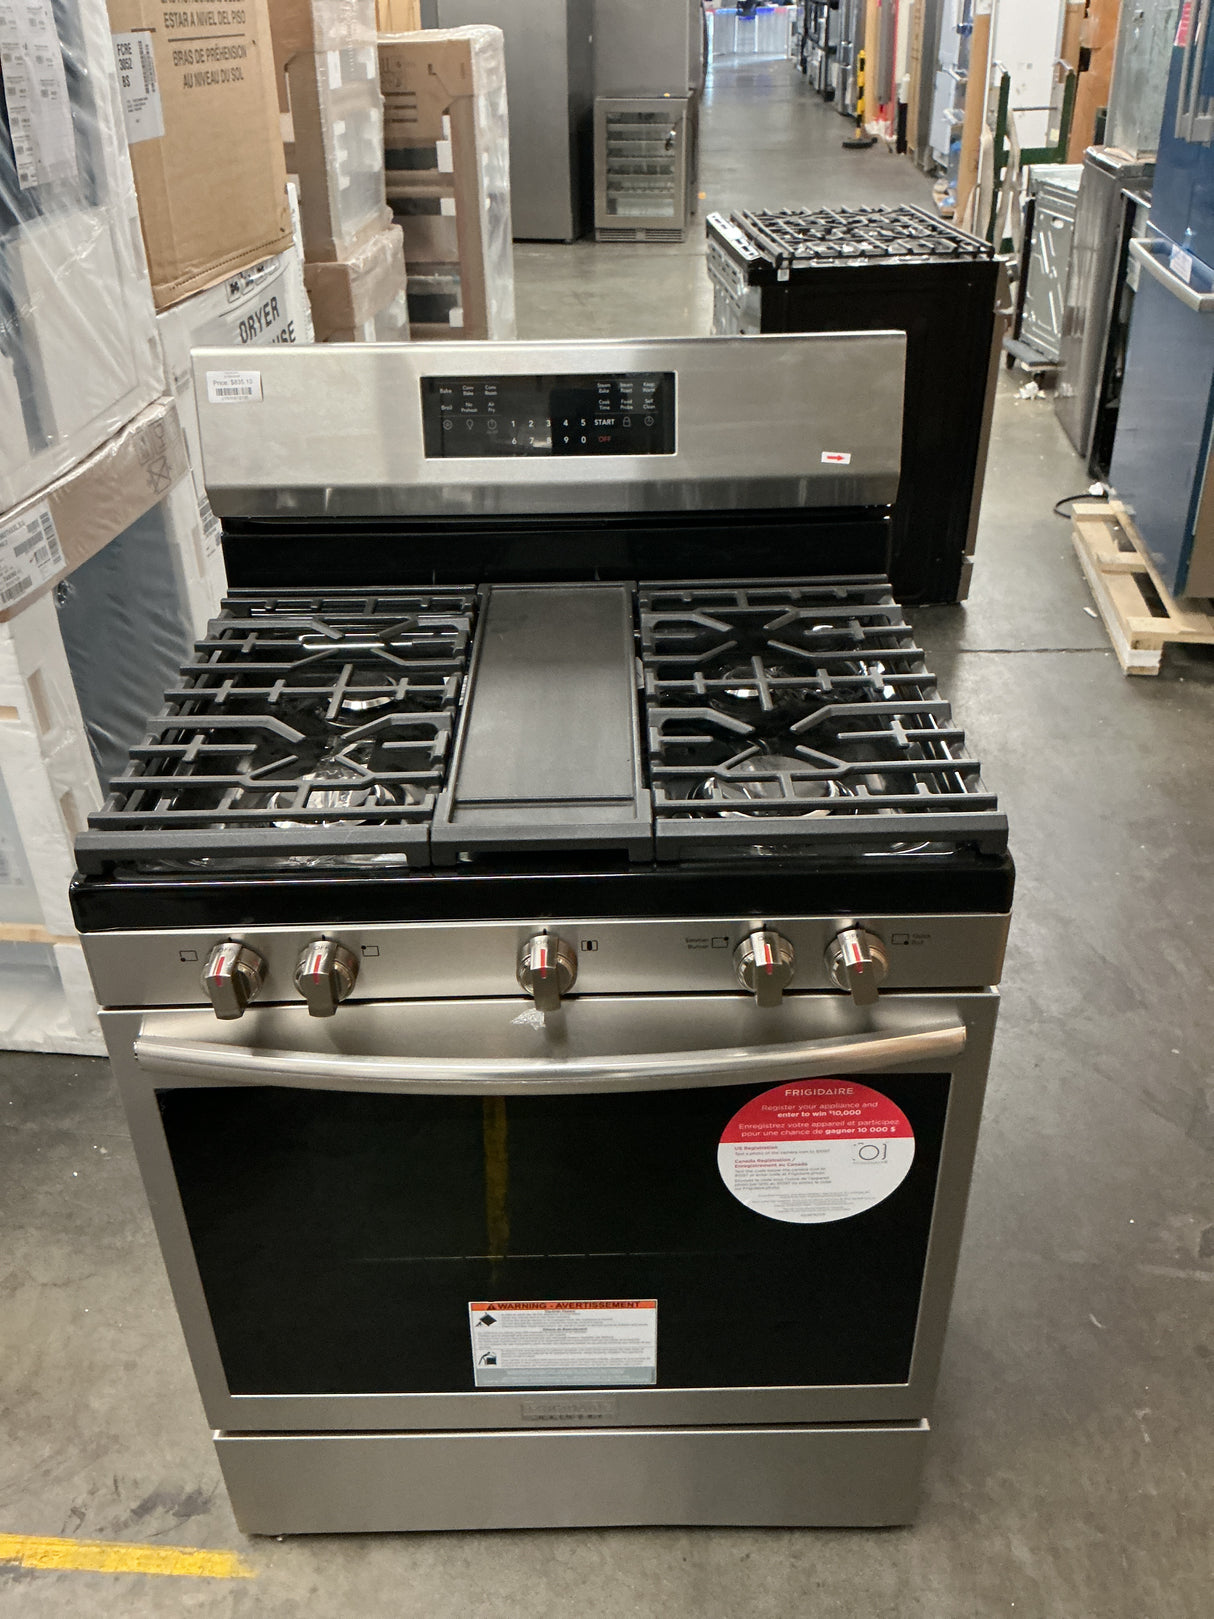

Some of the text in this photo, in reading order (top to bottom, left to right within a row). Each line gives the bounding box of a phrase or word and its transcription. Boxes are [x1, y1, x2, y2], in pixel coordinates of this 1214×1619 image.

[164, 10, 246, 28] ESTAR A NIVEL DEL PISO
[116, 42, 132, 56] FCRE
[172, 44, 247, 66] BRAS DE PRÉHENSION
[184, 67, 244, 88] AU NIVEAU DU SOL
[239, 296, 280, 344] DRYER
[546, 436, 552, 444] 8
[784, 1088, 854, 1096] FRIGIDAIRE
[738, 1122, 785, 1130] Enregistrez
[556, 1302, 640, 1310] AVERTISSEMENT
